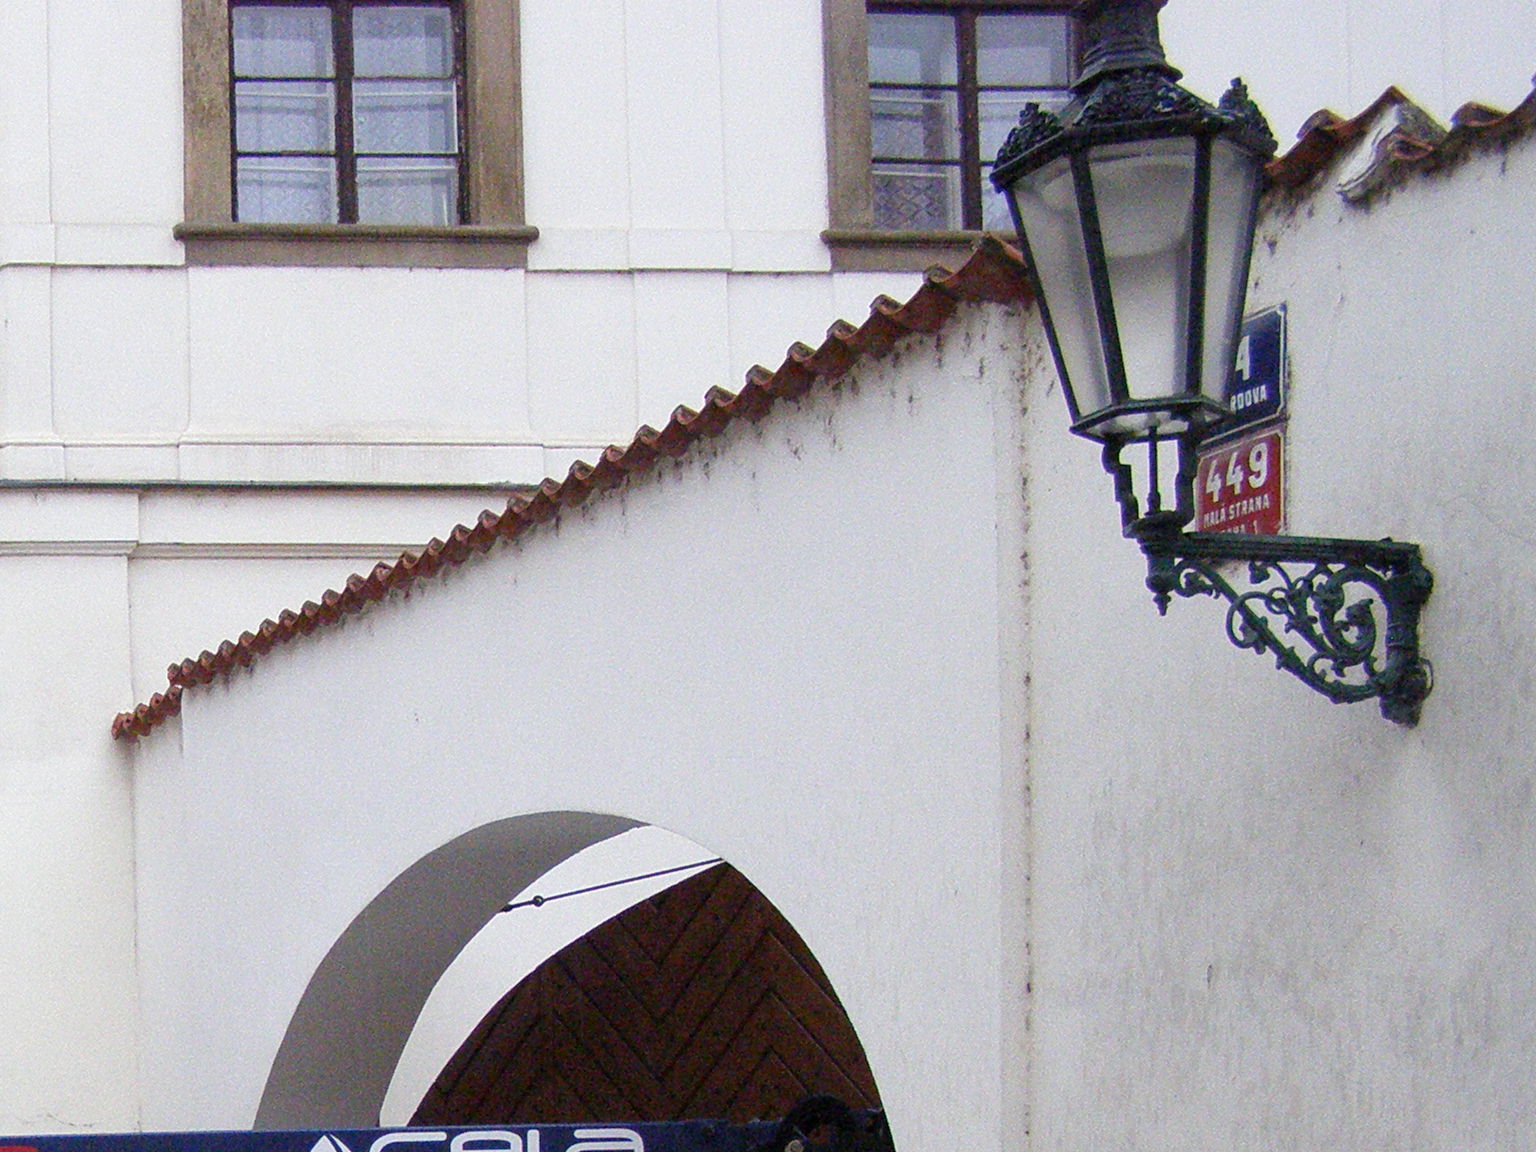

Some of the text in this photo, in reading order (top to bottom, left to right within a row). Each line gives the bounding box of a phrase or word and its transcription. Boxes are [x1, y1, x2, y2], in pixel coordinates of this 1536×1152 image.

[1234, 335, 1251, 382] 4
[1206, 442, 1269, 504] 449
[1228, 493, 1270, 520] STRANA
